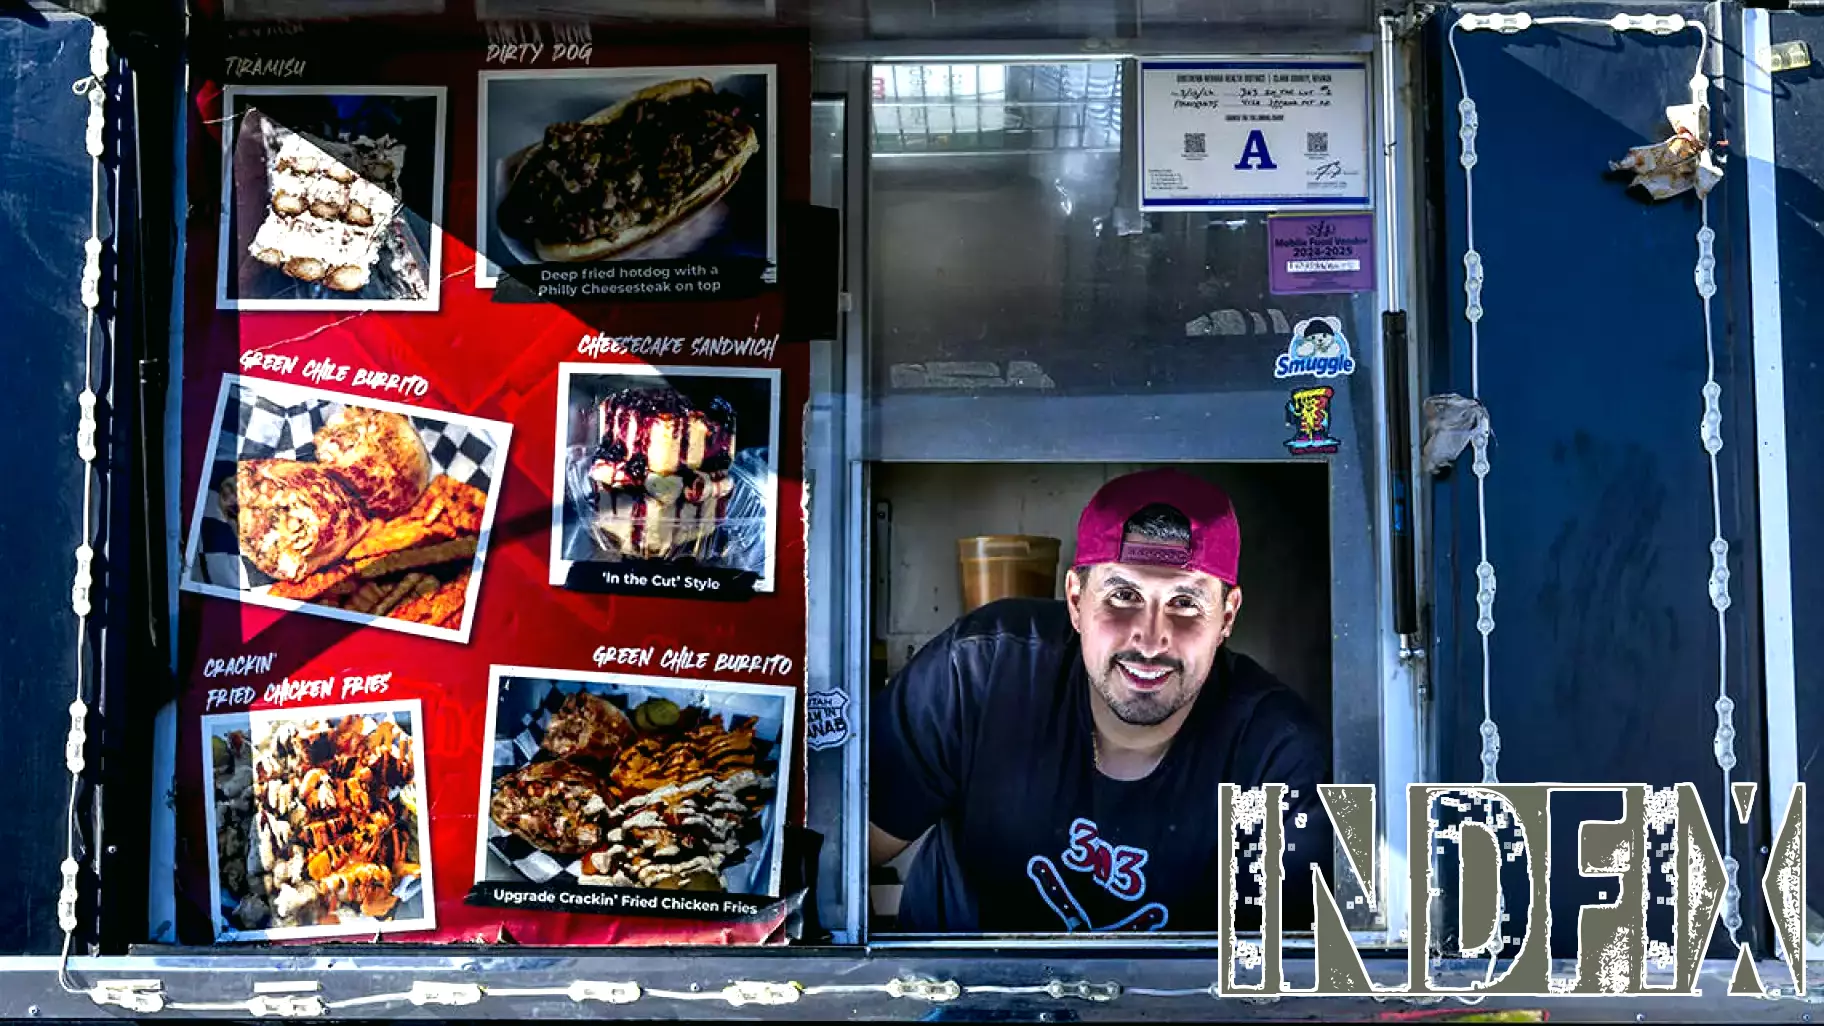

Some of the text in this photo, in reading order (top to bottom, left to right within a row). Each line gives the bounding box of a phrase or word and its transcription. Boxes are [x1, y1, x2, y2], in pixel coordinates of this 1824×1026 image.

[486, 42, 593, 65] DIRTY DOG
[225, 56, 307, 78] TIRAMISU
[1234, 130, 1278, 171] A
[541, 264, 719, 281] Deep fried hotdog with a
[538, 281, 721, 296] Philly Cheesesteak on top
[578, 332, 780, 361] CHEESECAKE SANDWICH
[240, 350, 429, 396] GREEN CHILE BURRITO
[1277, 356, 1353, 377] Smuggle
[623, 573, 648, 586] the
[651, 574, 681, 588] Cut'
[684, 576, 721, 592] Style
[203, 652, 278, 678] CRACKIN'
[592, 645, 793, 676] GREEN CHILE BURRITO
[206, 671, 392, 711] FRIED CHICKEN FRIES
[808, 717, 847, 738] ANAB
[1061, 817, 1149, 901] 303
[493, 889, 758, 915] Upgrade Crackin' Fried Chicken Fries
